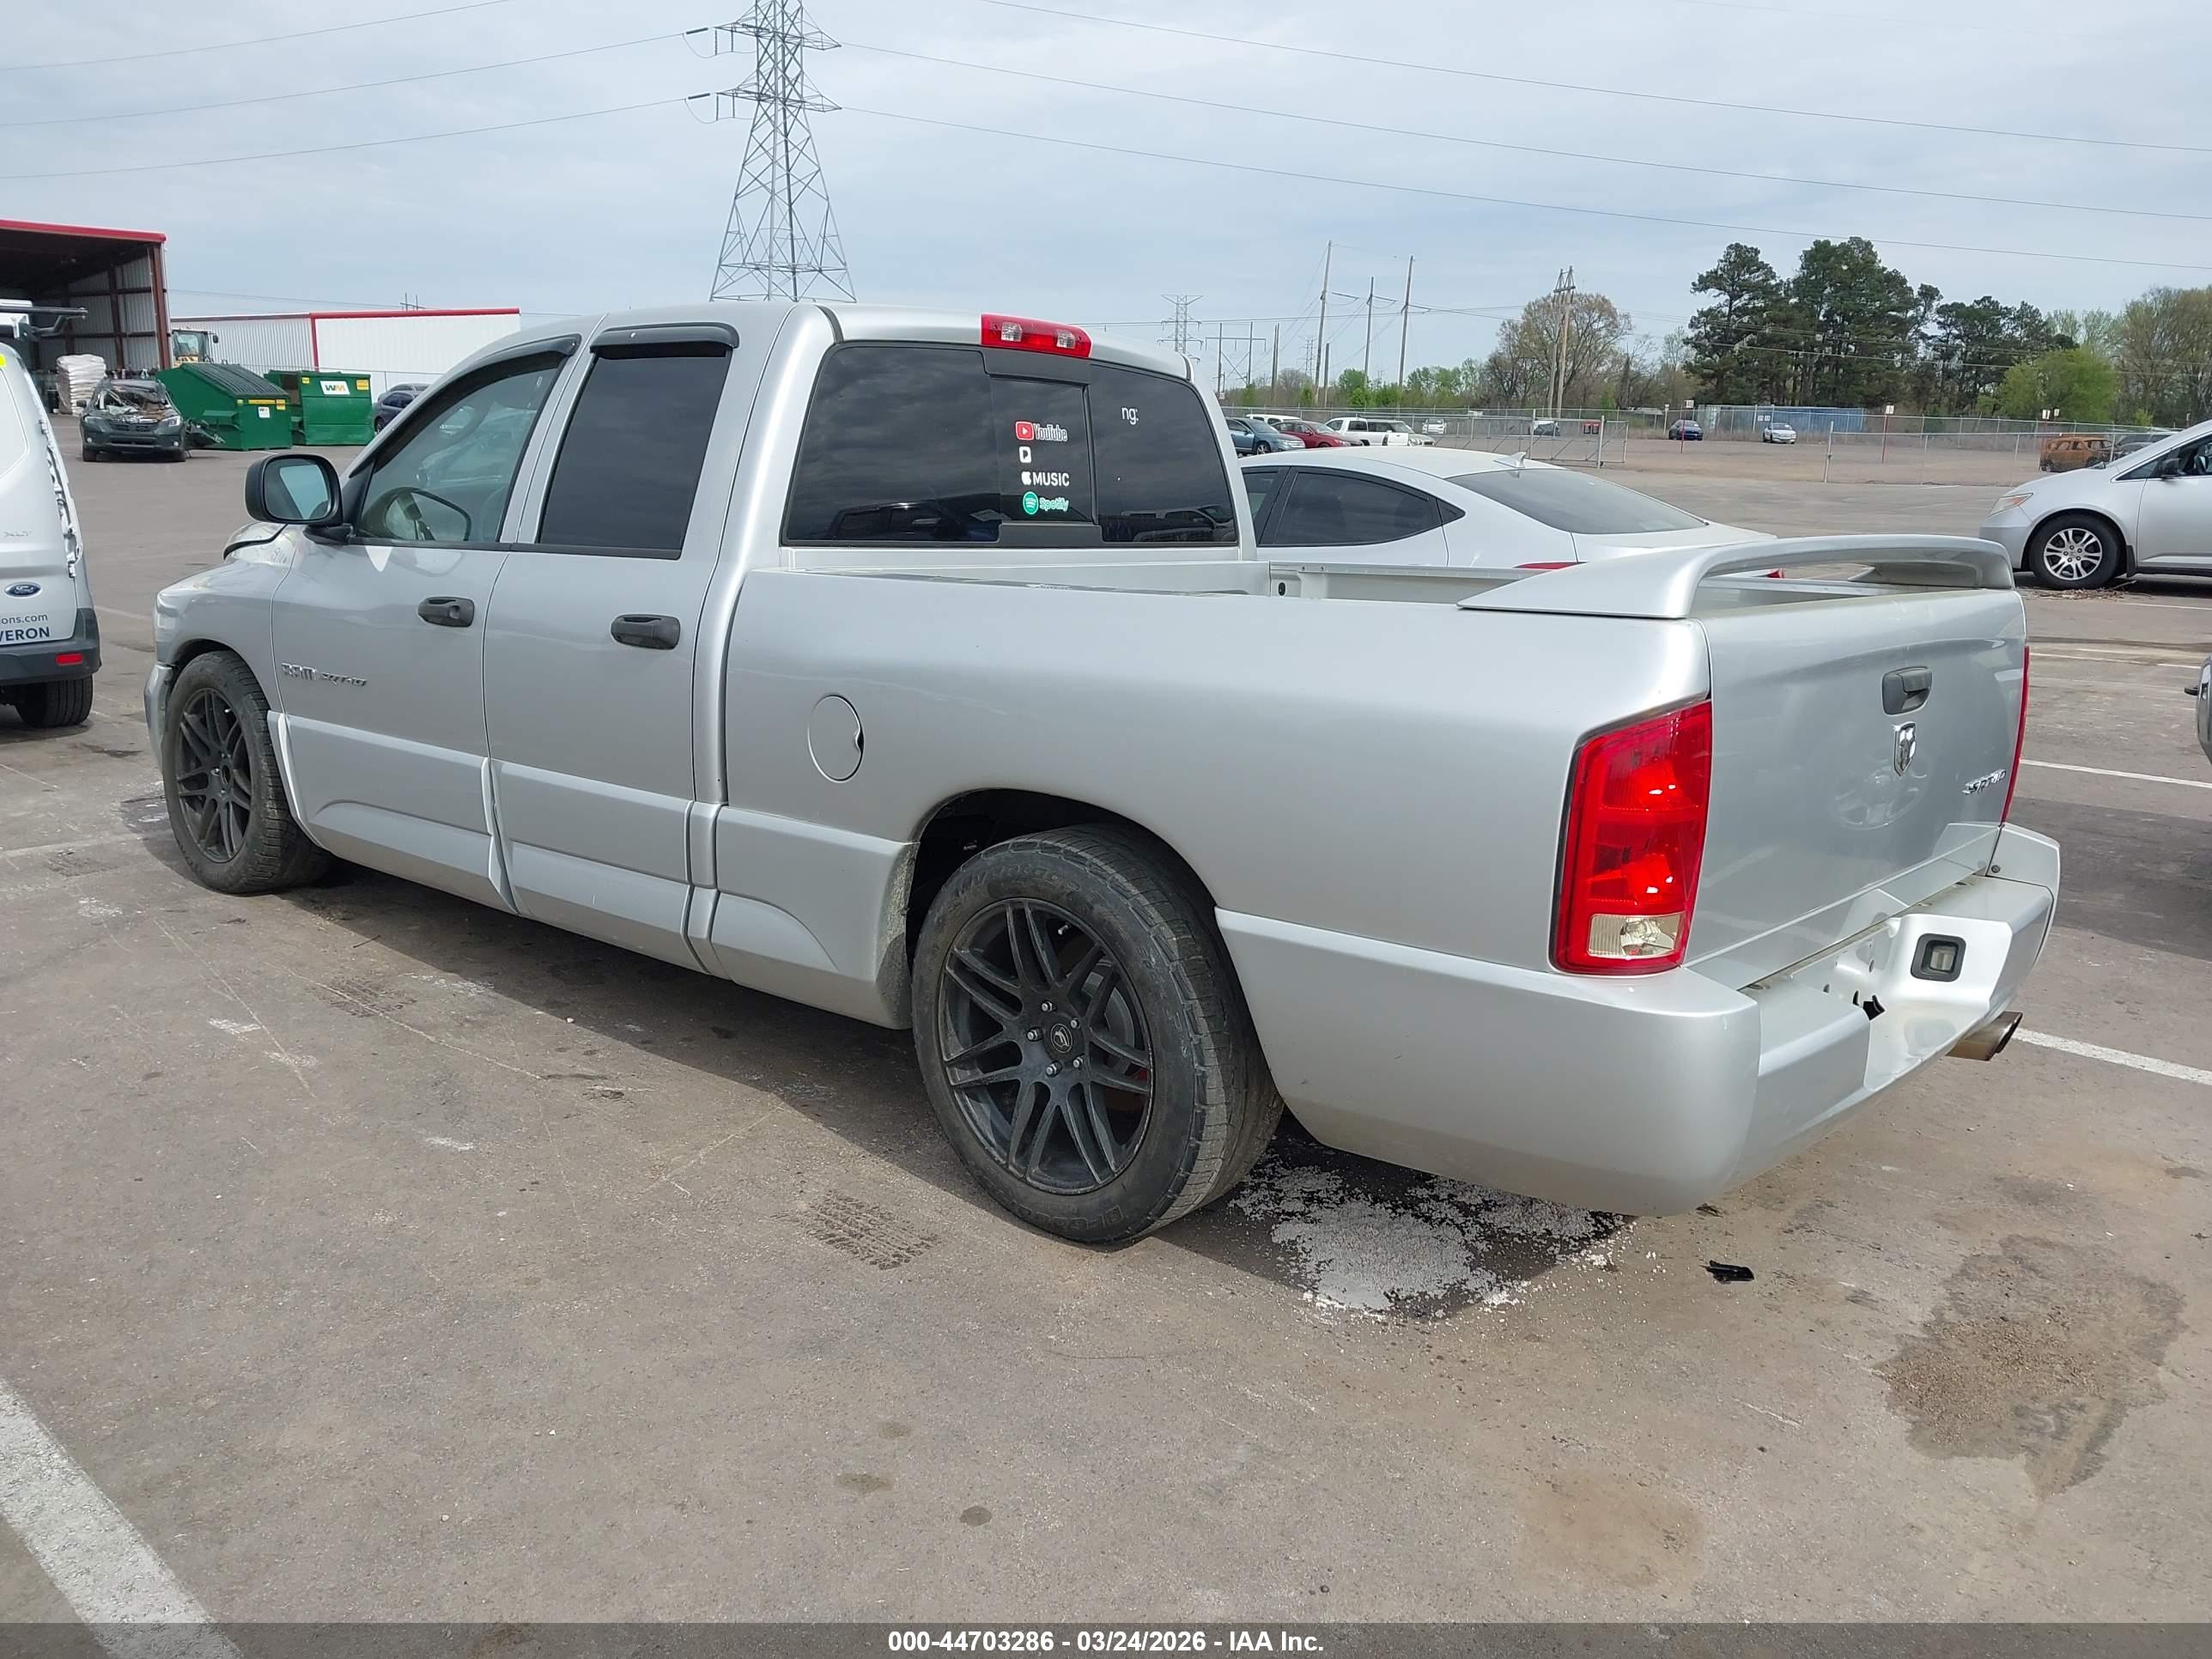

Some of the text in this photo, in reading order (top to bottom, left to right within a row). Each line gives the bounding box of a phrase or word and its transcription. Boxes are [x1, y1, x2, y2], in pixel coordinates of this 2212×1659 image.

[1033, 422, 1068, 441] YouTube
[1032, 471, 1070, 487] MUSIC
[1039, 496, 1069, 513] Spotify
[14, 585, 35, 594] Ford
